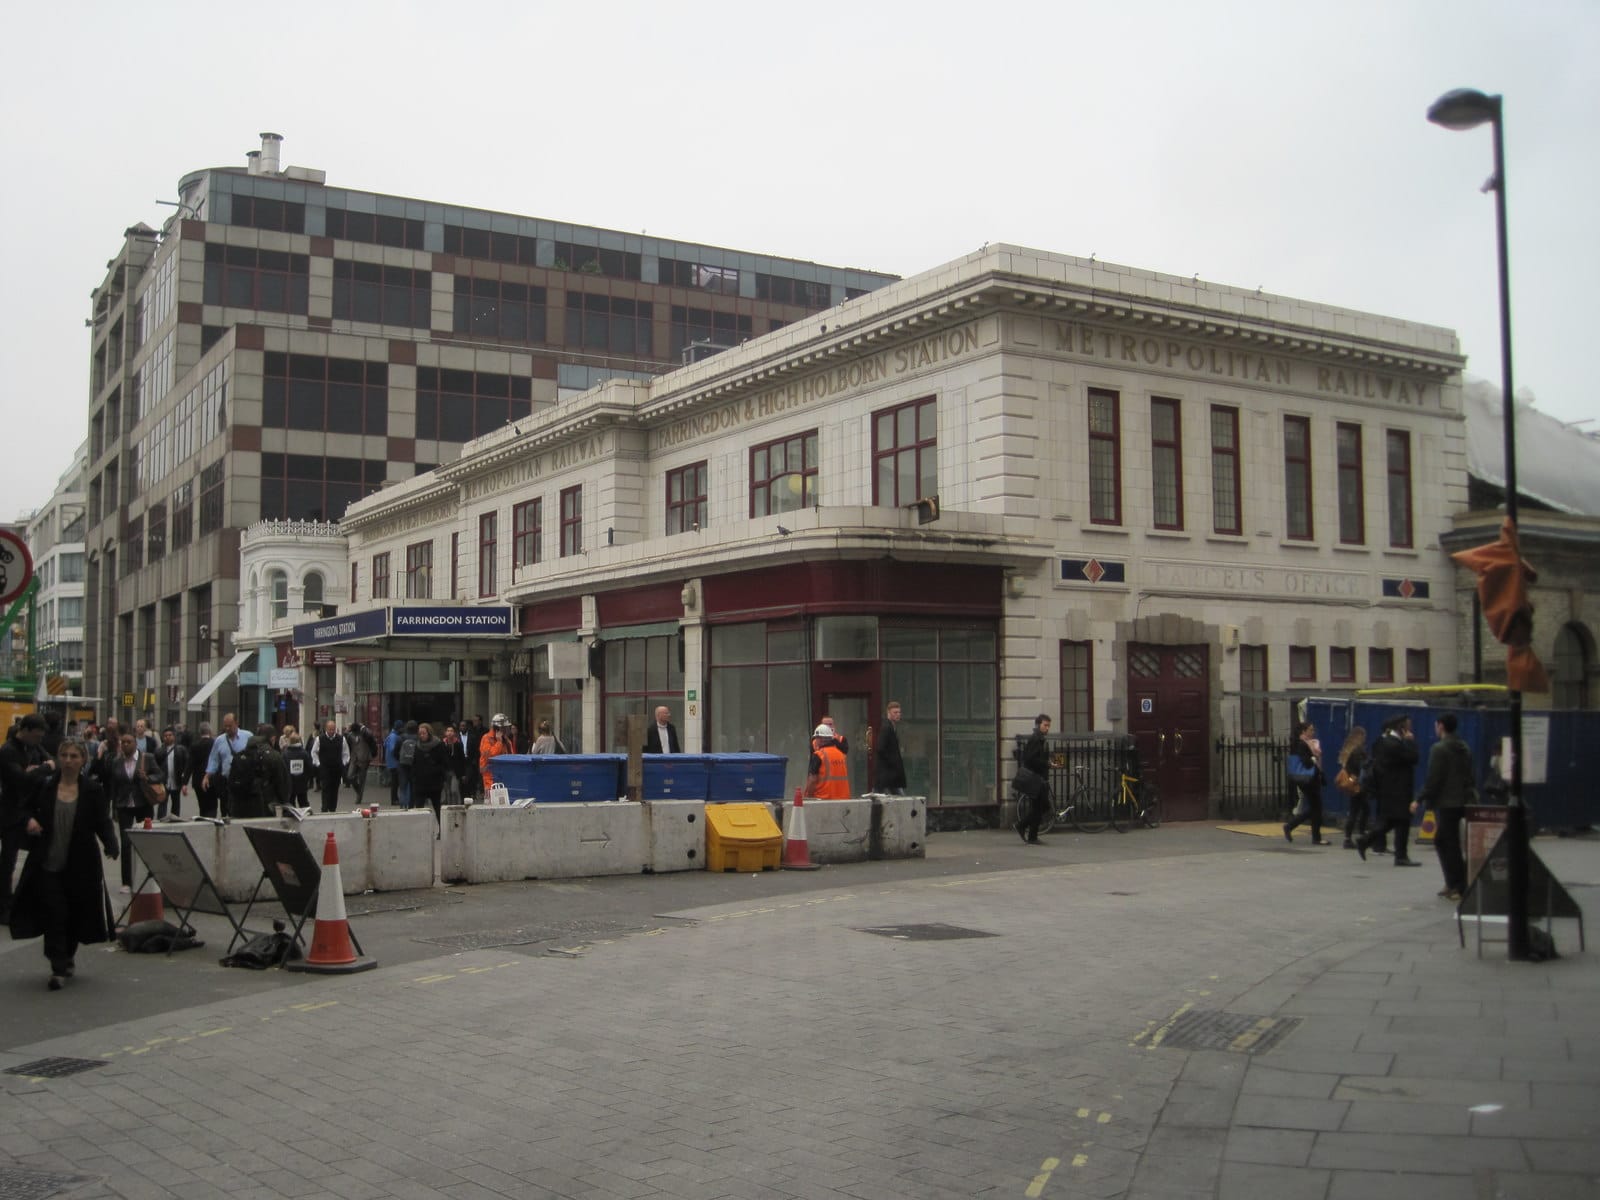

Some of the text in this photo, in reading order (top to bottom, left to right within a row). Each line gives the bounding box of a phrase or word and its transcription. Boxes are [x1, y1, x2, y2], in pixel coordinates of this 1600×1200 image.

[657, 323, 979, 450] FARRINGDON & HIGH HOLBORN STATION
[1055, 324, 1426, 406] METROPOLITAN RAILWAY
[464, 437, 605, 500] METROPOLITAN RAILWAY
[397, 615, 506, 626] FARRINGDON STATION
